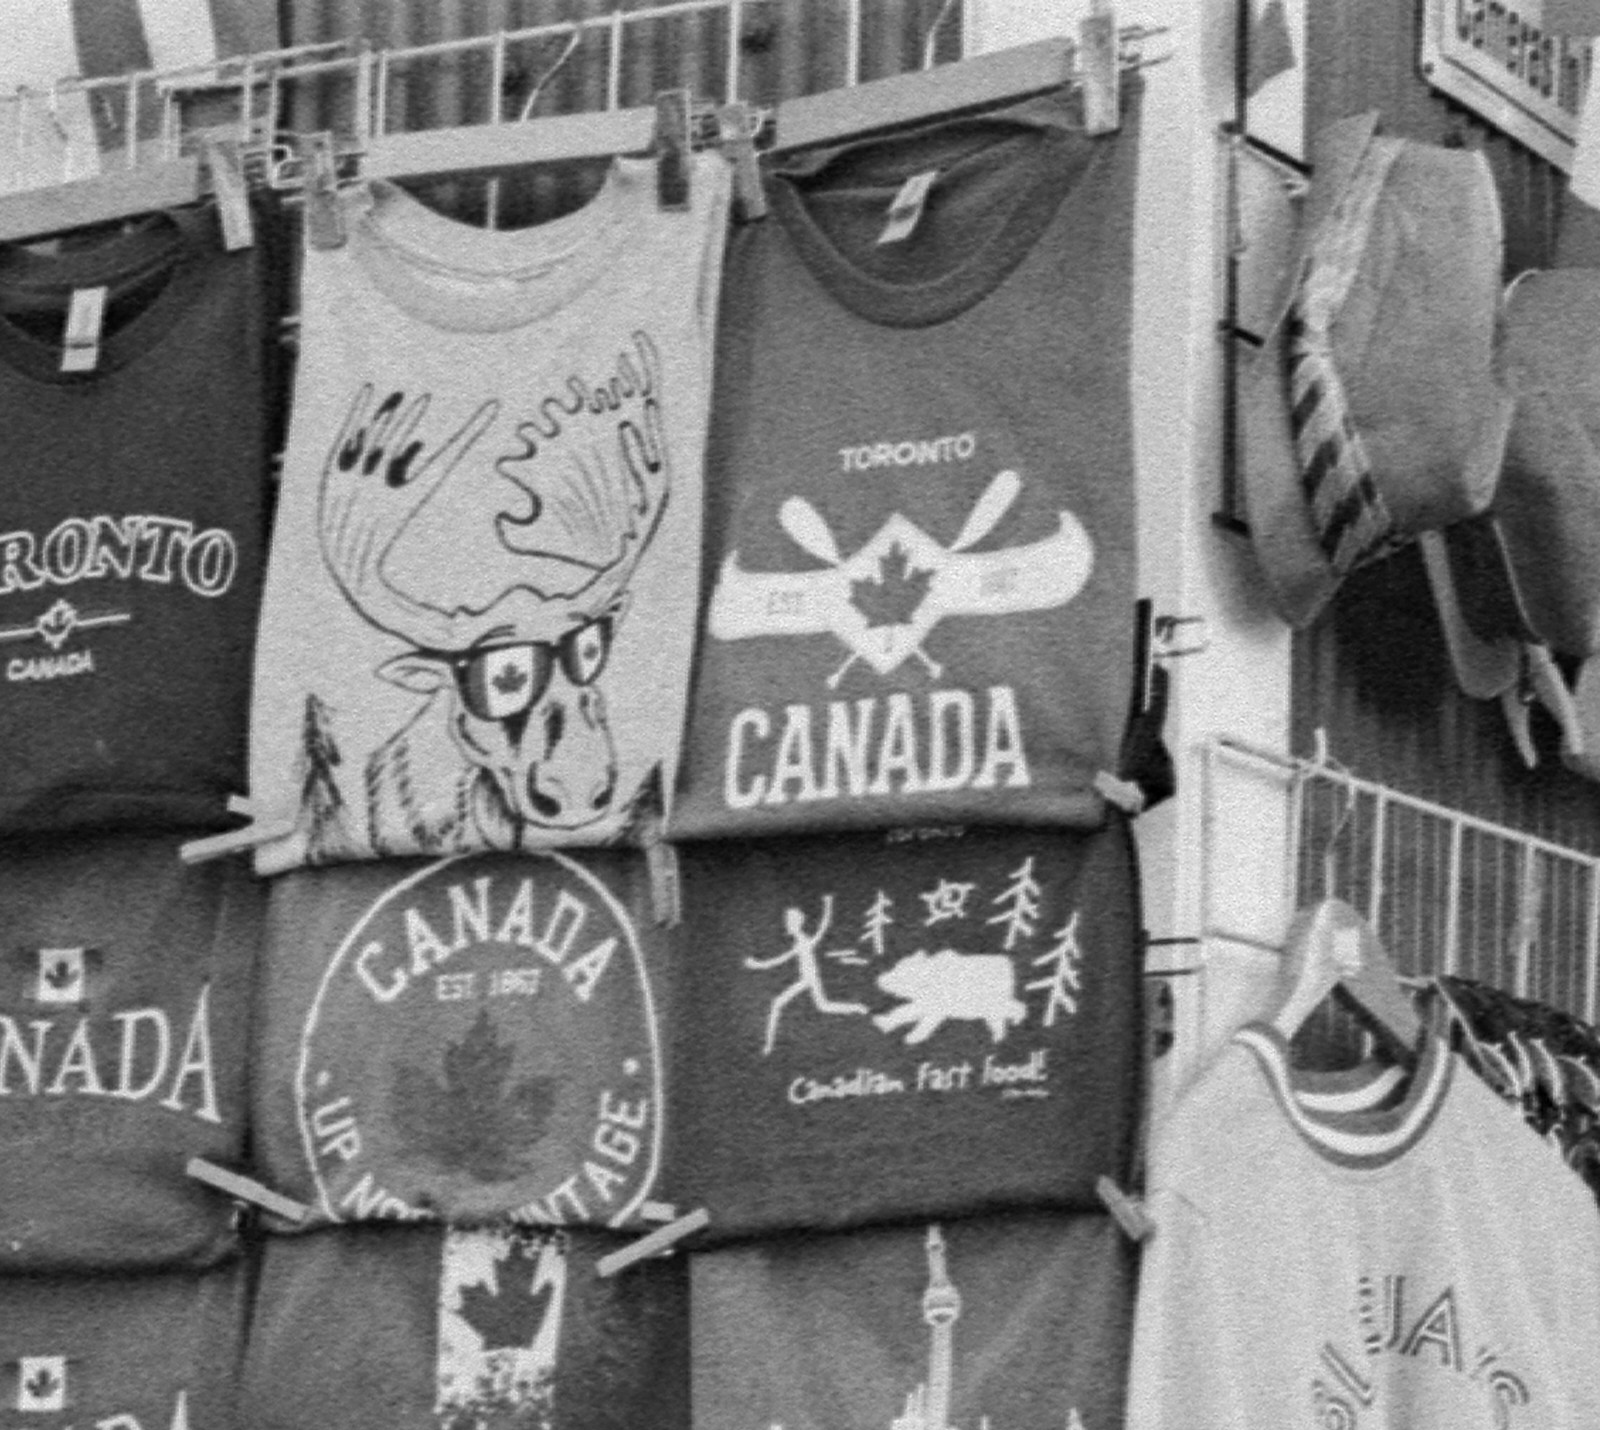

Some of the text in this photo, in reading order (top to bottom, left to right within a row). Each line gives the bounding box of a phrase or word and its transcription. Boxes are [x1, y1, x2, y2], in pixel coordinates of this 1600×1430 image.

[839, 433, 975, 471] TORONTO
[8, 650, 95, 681] CANADA
[725, 686, 1030, 808] CANADA
[356, 877, 619, 1002] CANADA
[312, 1096, 362, 1161] UP
